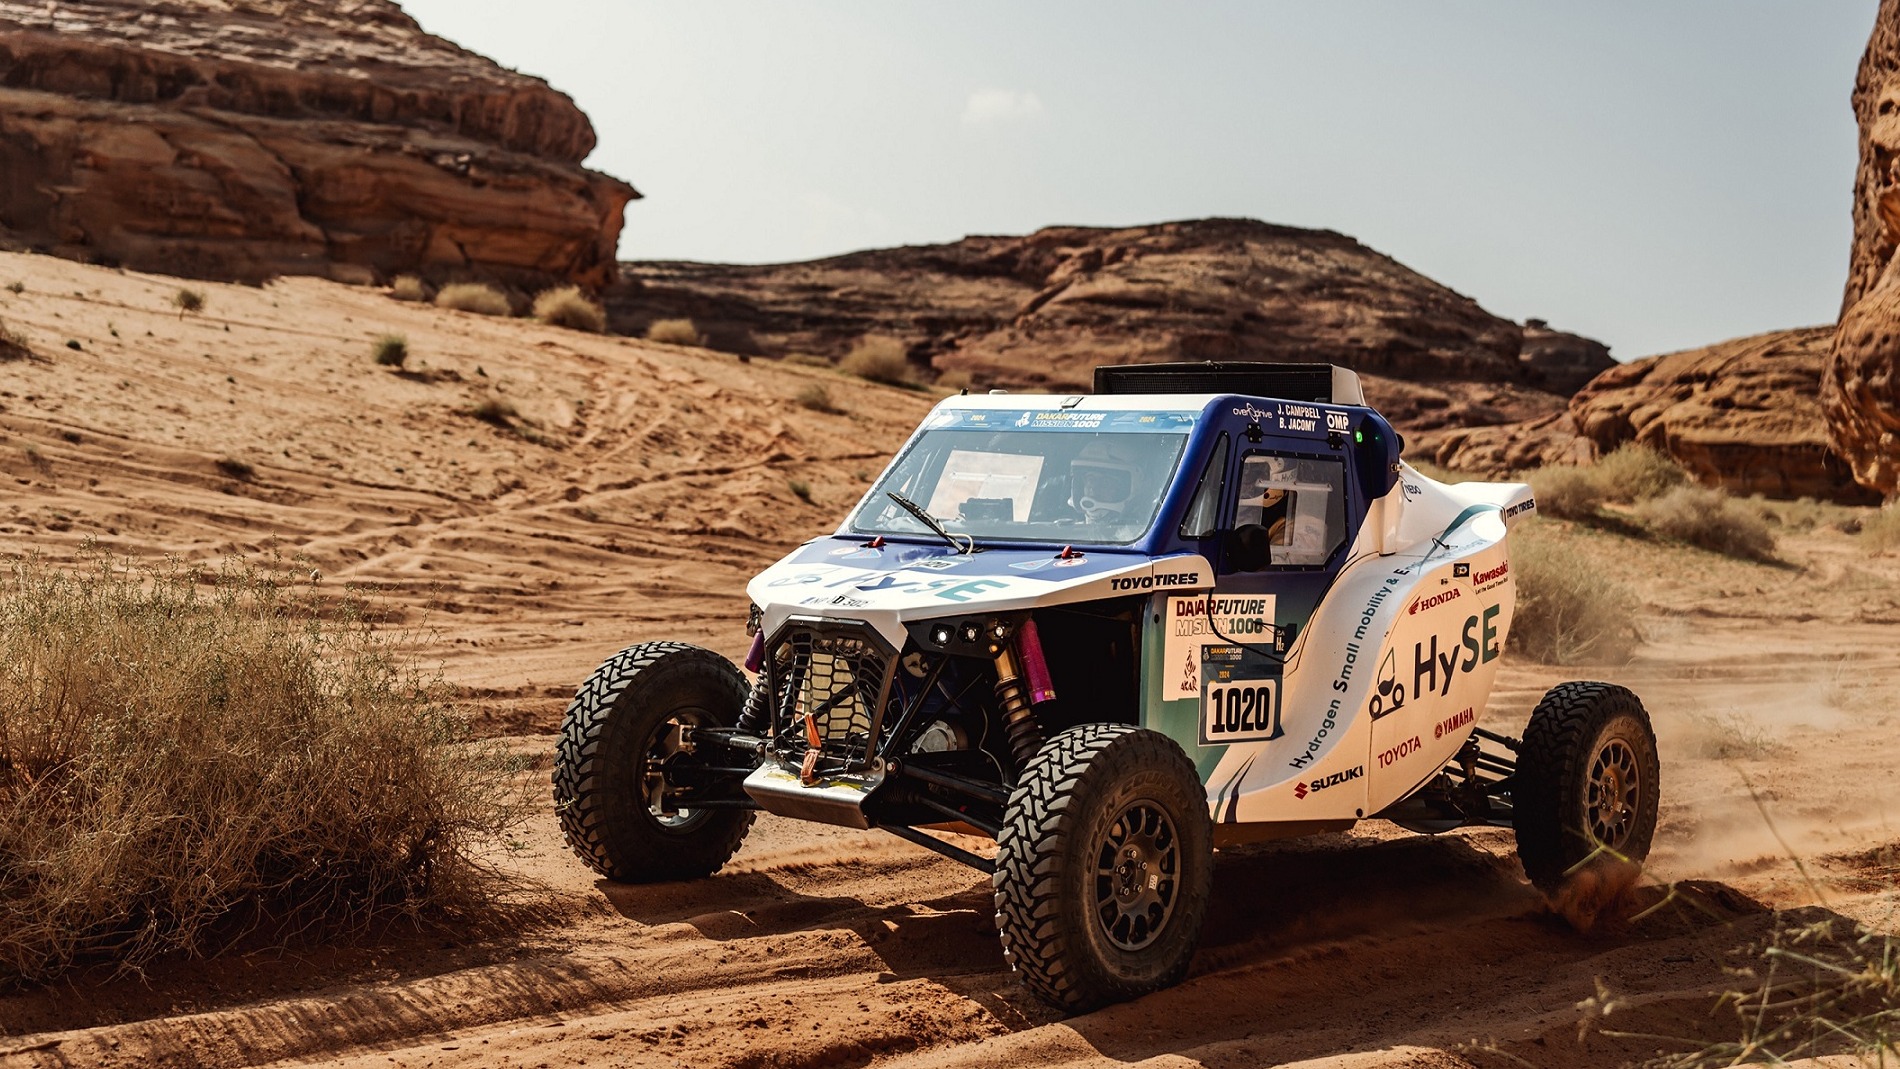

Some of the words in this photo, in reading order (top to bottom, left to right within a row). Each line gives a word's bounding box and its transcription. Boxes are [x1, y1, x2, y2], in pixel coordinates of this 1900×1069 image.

[1277, 403, 1285, 415] J.
[1285, 404, 1321, 419] CAMPBELL
[1279, 417, 1287, 429] B.
[1287, 418, 1316, 432] JACOMY
[1326, 413, 1349, 430] OMP
[1110, 576, 1153, 590] TOYO
[1153, 572, 1199, 586] TIRES
[1472, 559, 1508, 587] Kawasaki
[1420, 588, 1461, 612] HONDA
[1413, 603, 1500, 701] HySE
[1289, 698, 1341, 770] Hydrogen
[1333, 642, 1360, 693] Small
[1354, 585, 1393, 641] mobility
[1385, 578, 1400, 589] &
[1211, 686, 1271, 734] 1020
[1442, 706, 1475, 735] YAMAHA
[1377, 735, 1422, 769] TOYOTA
[1310, 764, 1364, 793] SUZUKI
